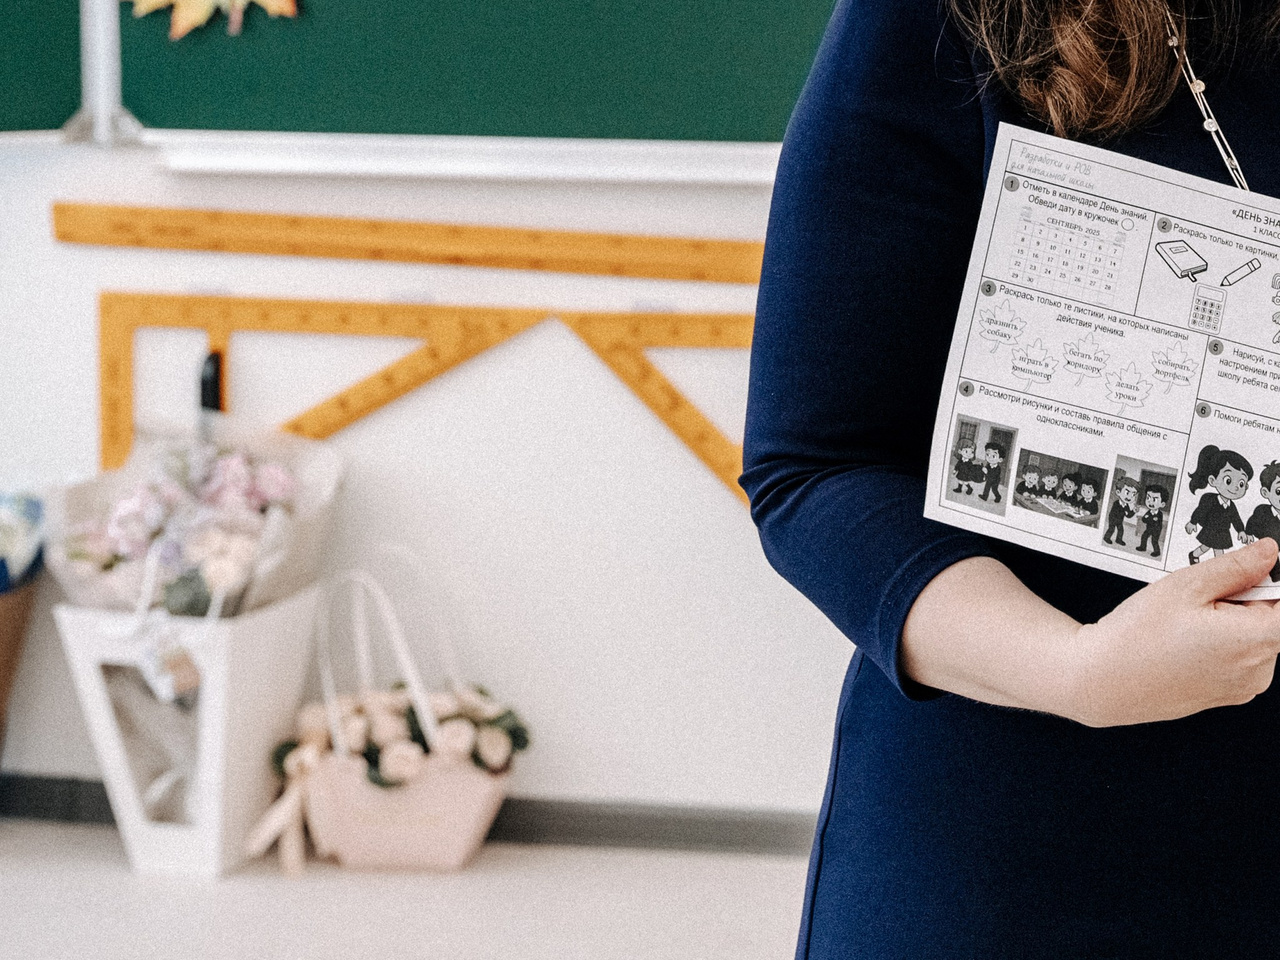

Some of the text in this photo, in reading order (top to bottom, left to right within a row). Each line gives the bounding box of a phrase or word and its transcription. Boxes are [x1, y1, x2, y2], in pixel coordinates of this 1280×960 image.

[1021, 179, 1050, 195] Отметь
[1058, 191, 1098, 209] календаре
[1099, 200, 1119, 213] День
[1120, 208, 1149, 221] знаний.
[1027, 193, 1057, 211] Обведи
[1057, 204, 1076, 216] дату
[1077, 209, 1082, 217] в
[1083, 211, 1119, 226] кружочек
[1231, 207, 1263, 223] «ДЕНЬ
[1045, 216, 1100, 236] СЕНТЯБРЬ 2025
[1160, 220, 1168, 230] 2
[1252, 225, 1257, 233] 1
[1172, 223, 1208, 240] Раскрась
[1208, 234, 1233, 247] только
[1234, 241, 1244, 250] те
[1244, 244, 1280, 261] картинки,
[984, 283, 992, 293] 3
[998, 283, 1189, 341] Раскрась только те листики, на которых написаны
[983, 316, 1019, 330] дразнить
[1055, 312, 1126, 338] действия ученика.
[985, 327, 1013, 341] собаку
[1212, 342, 1219, 352] 5
[1018, 354, 1043, 367] играть
[1067, 348, 1103, 363] бегать по
[1232, 347, 1266, 365] Нарисуй,
[1156, 357, 1191, 371] собирать
[1218, 358, 1267, 377] настроением
[1114, 379, 1140, 392] делать
[1217, 369, 1241, 383] школу
[1242, 376, 1268, 389] ребята
[962, 384, 969, 393] 4
[1113, 390, 1137, 402] уроки
[977, 385, 1168, 441] Рассмотри рисунки и составь правила общения с
[1200, 406, 1207, 415] 6
[1035, 413, 1105, 438] одноклассниками.
[1212, 409, 1242, 424] Помоги
[1242, 417, 1276, 433] ребятам
